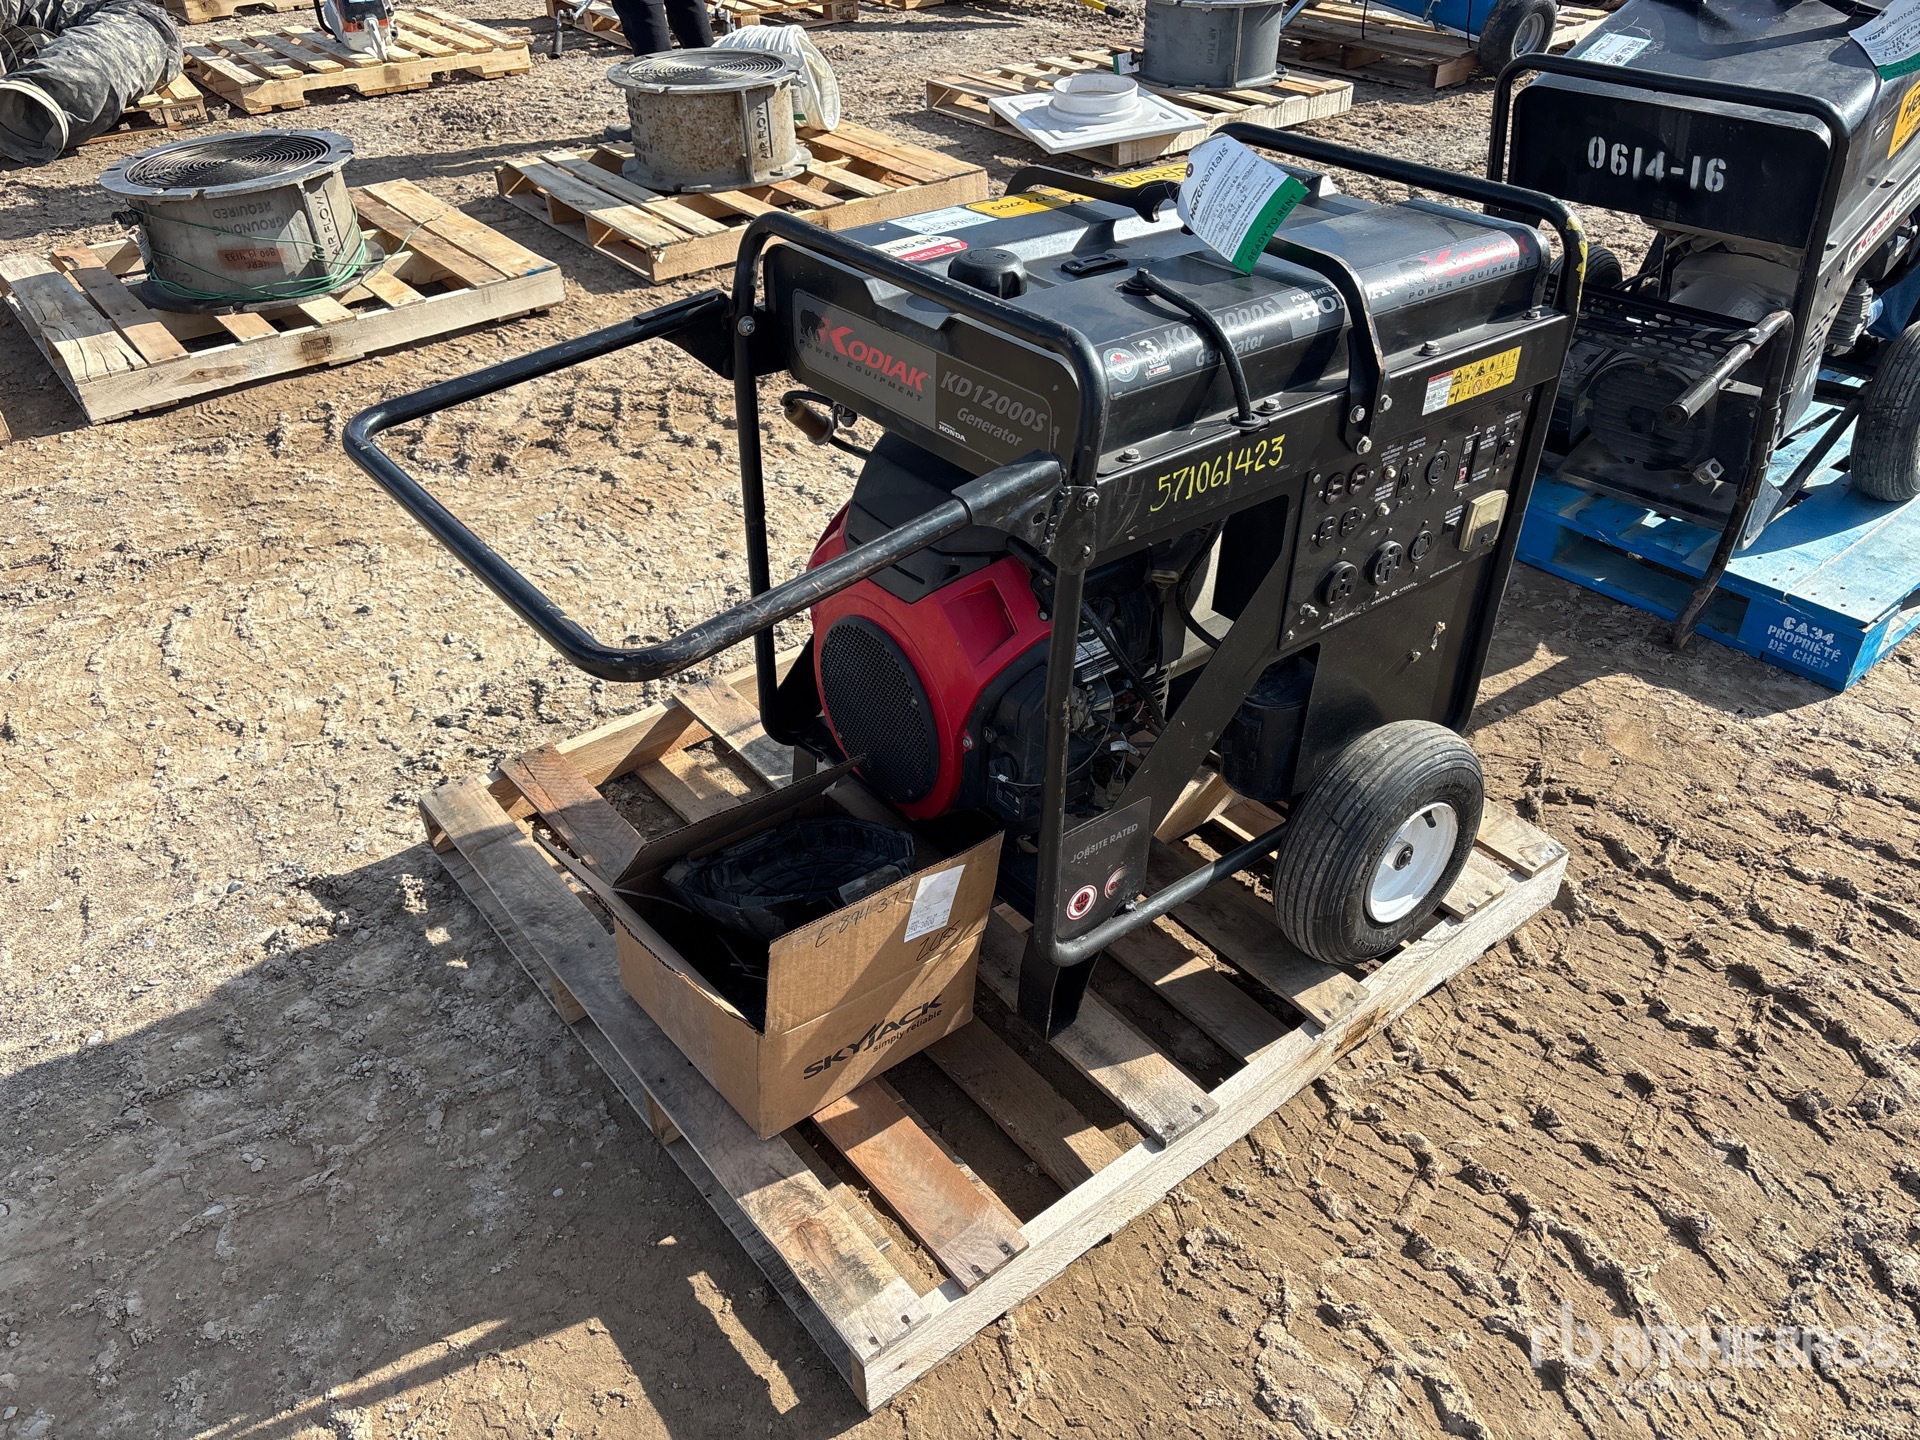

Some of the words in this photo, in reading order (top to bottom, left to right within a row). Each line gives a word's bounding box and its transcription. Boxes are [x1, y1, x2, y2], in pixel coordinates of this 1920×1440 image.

[1588, 136, 1726, 192] 0614-16
[212, 216, 284, 236] GROUNDING
[213, 201, 272, 219] REQUIRED
[1247, 230, 1269, 262] READY
[1267, 217, 1279, 231] TO
[1277, 194, 1298, 218] RENT
[918, 236, 941, 246] GAS
[1409, 281, 1453, 300] POWER
[1460, 257, 1532, 284] EQUIPMENT
[828, 325, 930, 392] KODIAK
[1139, 340, 1158, 357] 3
[800, 338, 845, 362] POWER
[847, 361, 924, 402] EQUIPMENT
[939, 370, 1048, 432] KD12000S
[938, 423, 967, 442] HONDA
[956, 407, 1023, 447] Generator
[1150, 434, 1286, 512] 571061423
[1768, 639, 1787, 655] DE
[1783, 616, 1834, 645] CA34
[1071, 838, 1108, 863] JOBSITE
[1109, 823, 1138, 843] RATED
[803, 994, 942, 1079] SKYJACK
[873, 1030, 905, 1053] simply
[905, 1009, 942, 1034] reliable
